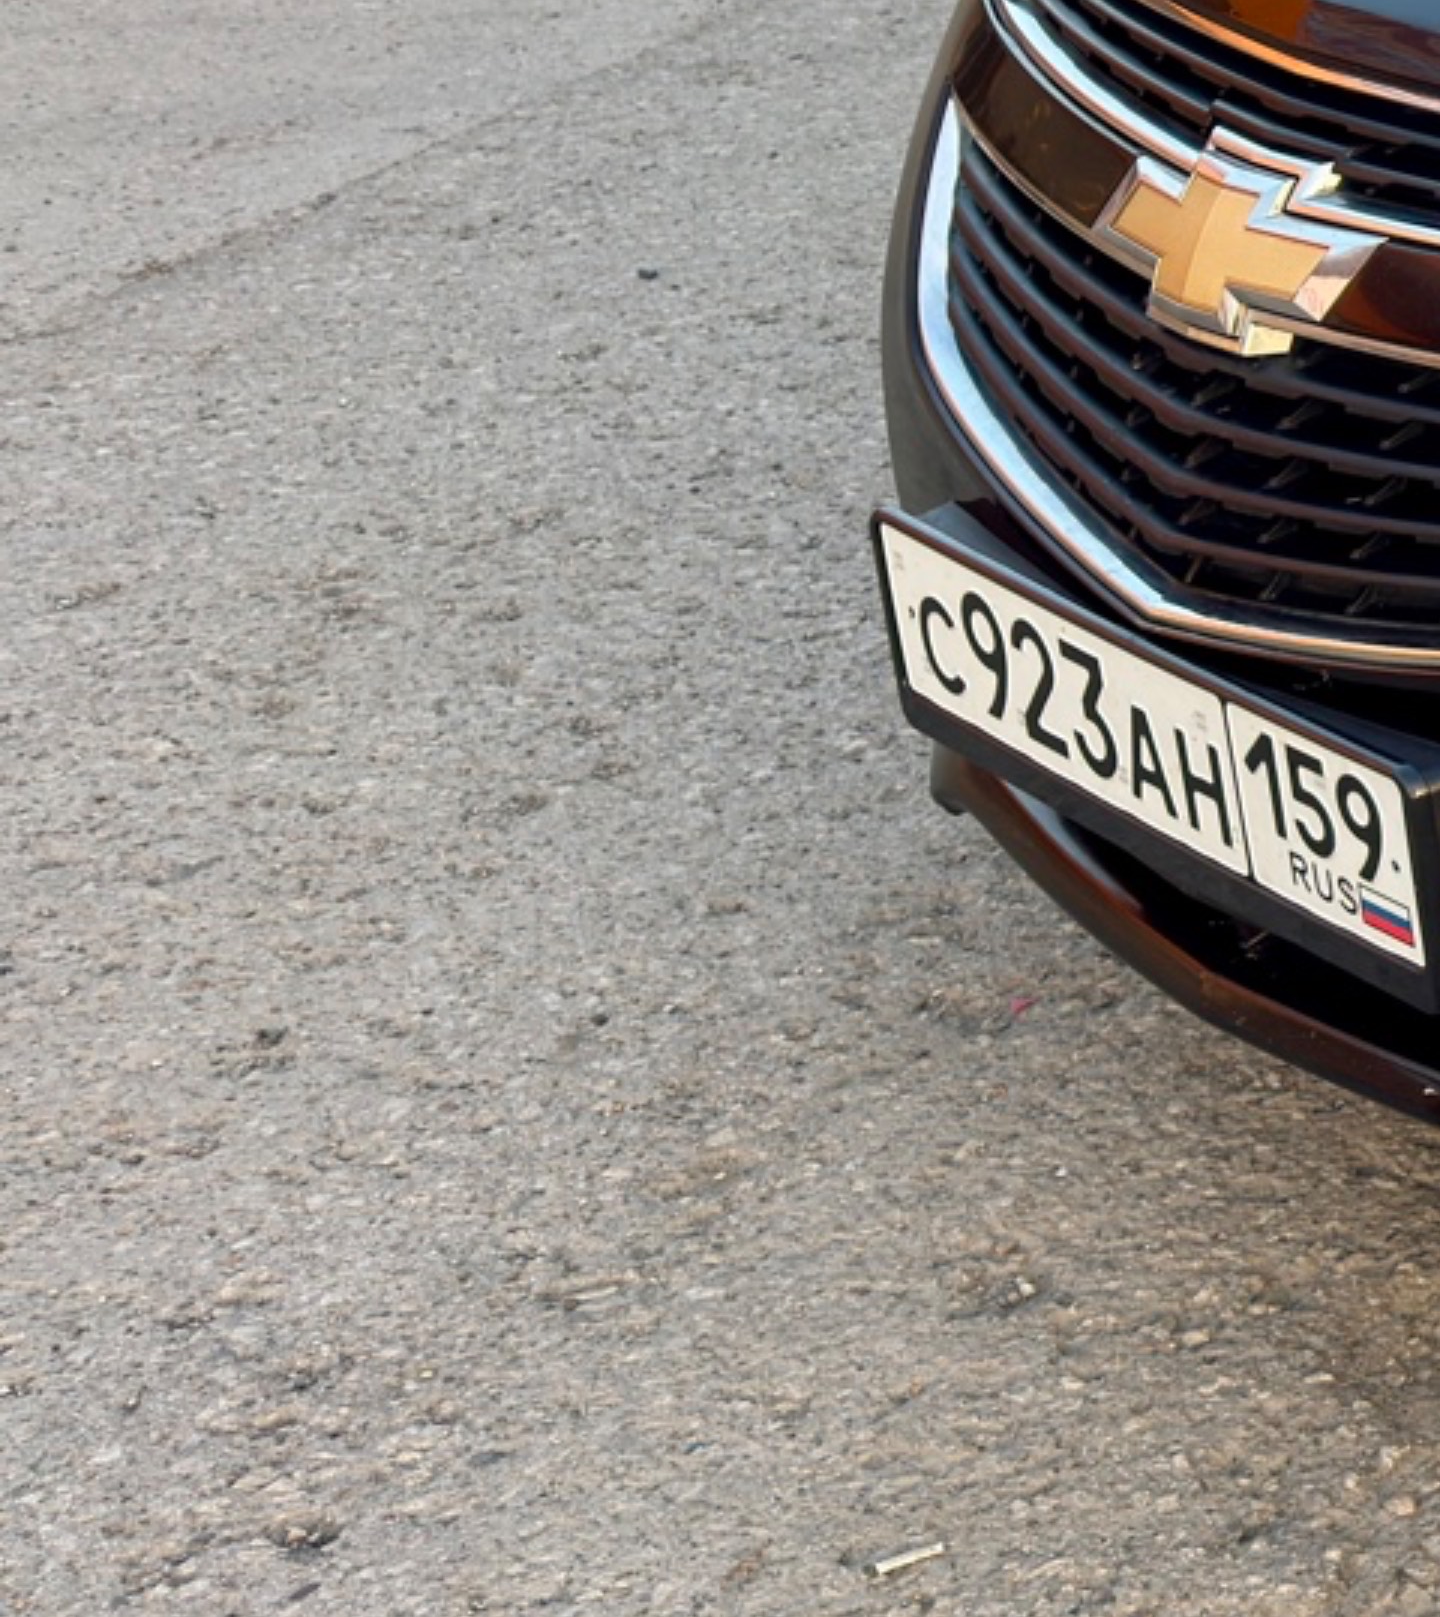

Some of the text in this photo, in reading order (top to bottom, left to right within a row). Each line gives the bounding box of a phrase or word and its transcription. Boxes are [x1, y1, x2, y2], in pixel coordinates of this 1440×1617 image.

[919, 591, 1383, 882] С923АН 159
[1288, 850, 1360, 916] RUS
